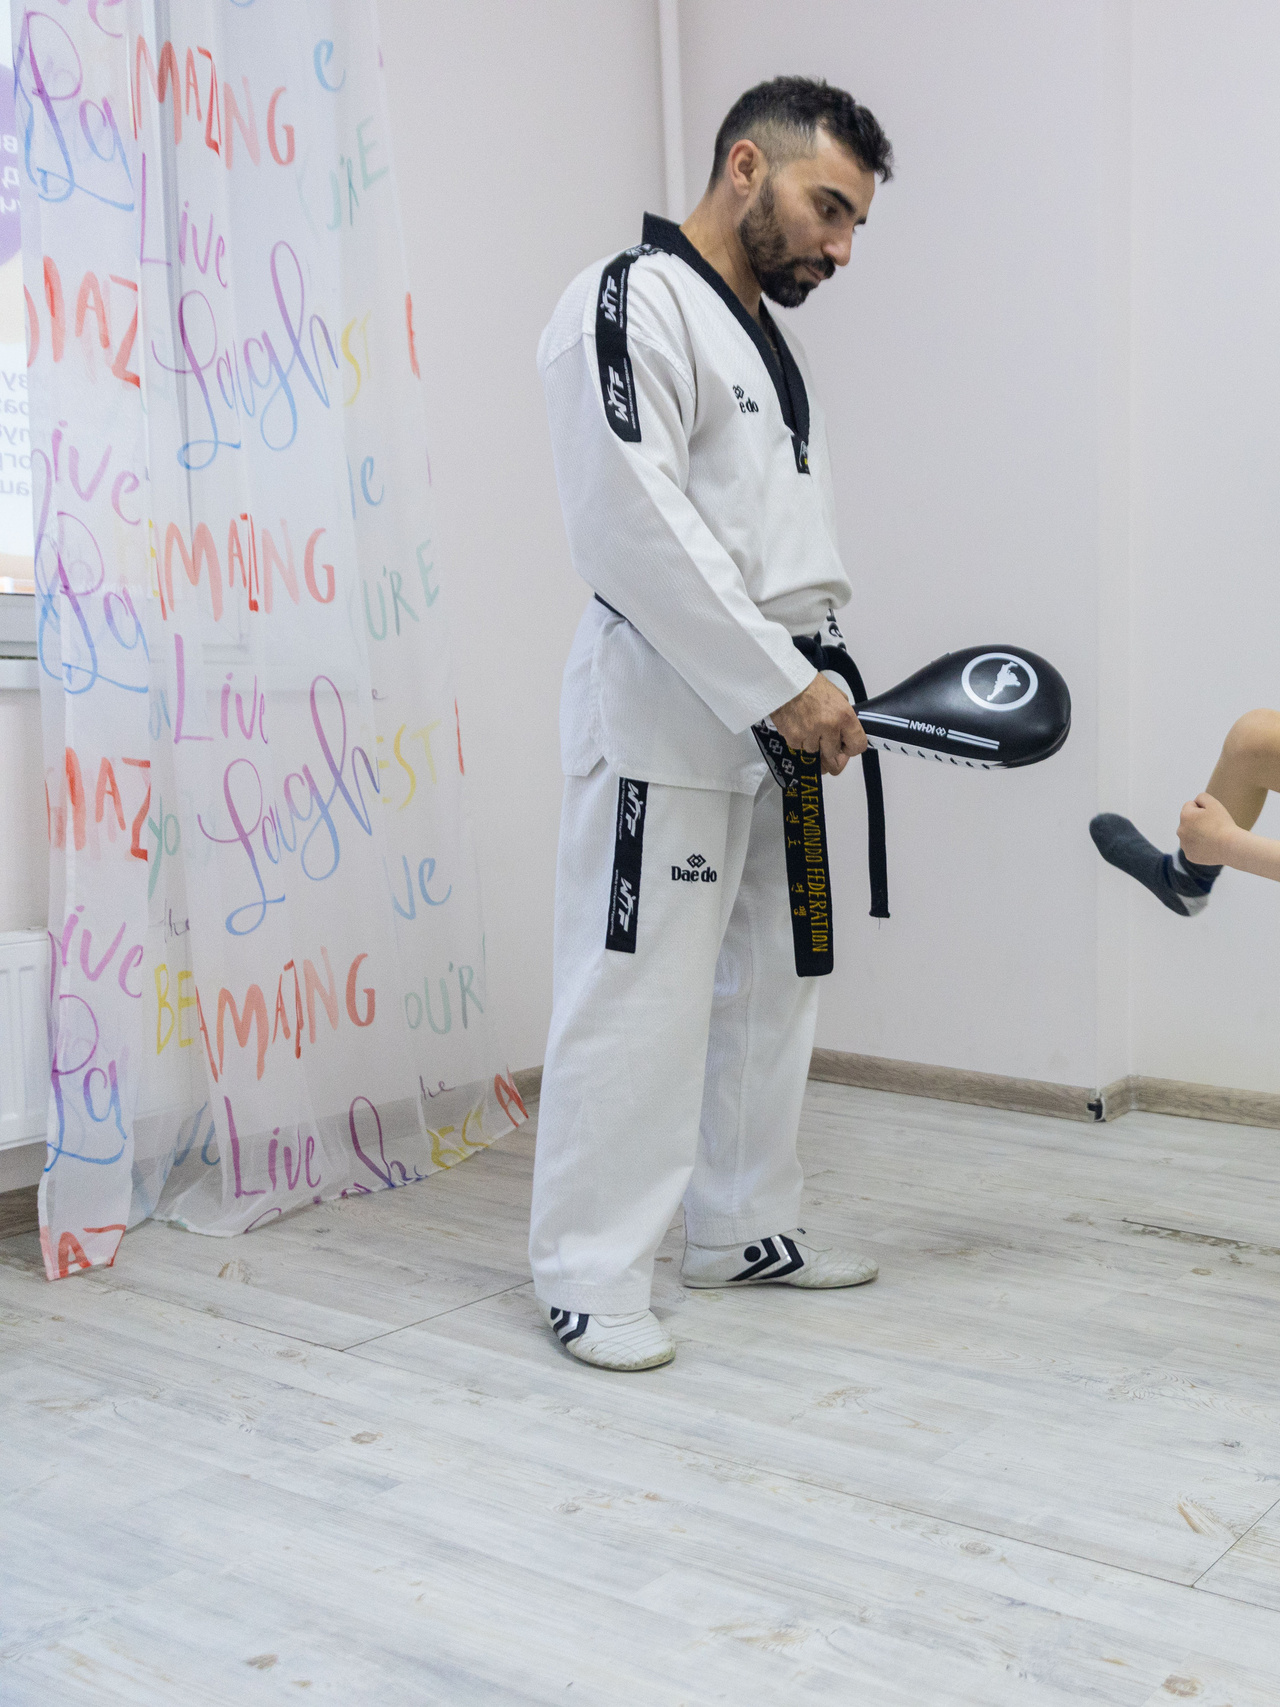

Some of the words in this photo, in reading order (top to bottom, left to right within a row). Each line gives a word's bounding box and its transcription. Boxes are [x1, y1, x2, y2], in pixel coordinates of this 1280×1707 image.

[140, 151, 228, 289] Live
[600, 275, 618, 323] WTF
[607, 365, 629, 423] WTF
[739, 397, 759, 414] edo
[52, 420, 142, 526] ive
[173, 633, 269, 744] Live
[910, 719, 935, 736] KHAN
[626, 781, 644, 839] WTF
[800, 773, 822, 863] TAEKWONDO
[618, 877, 637, 933] WTF
[806, 867, 828, 952] FEDERATION
[59, 905, 144, 999] ive
[224, 1096, 321, 1198] Live
